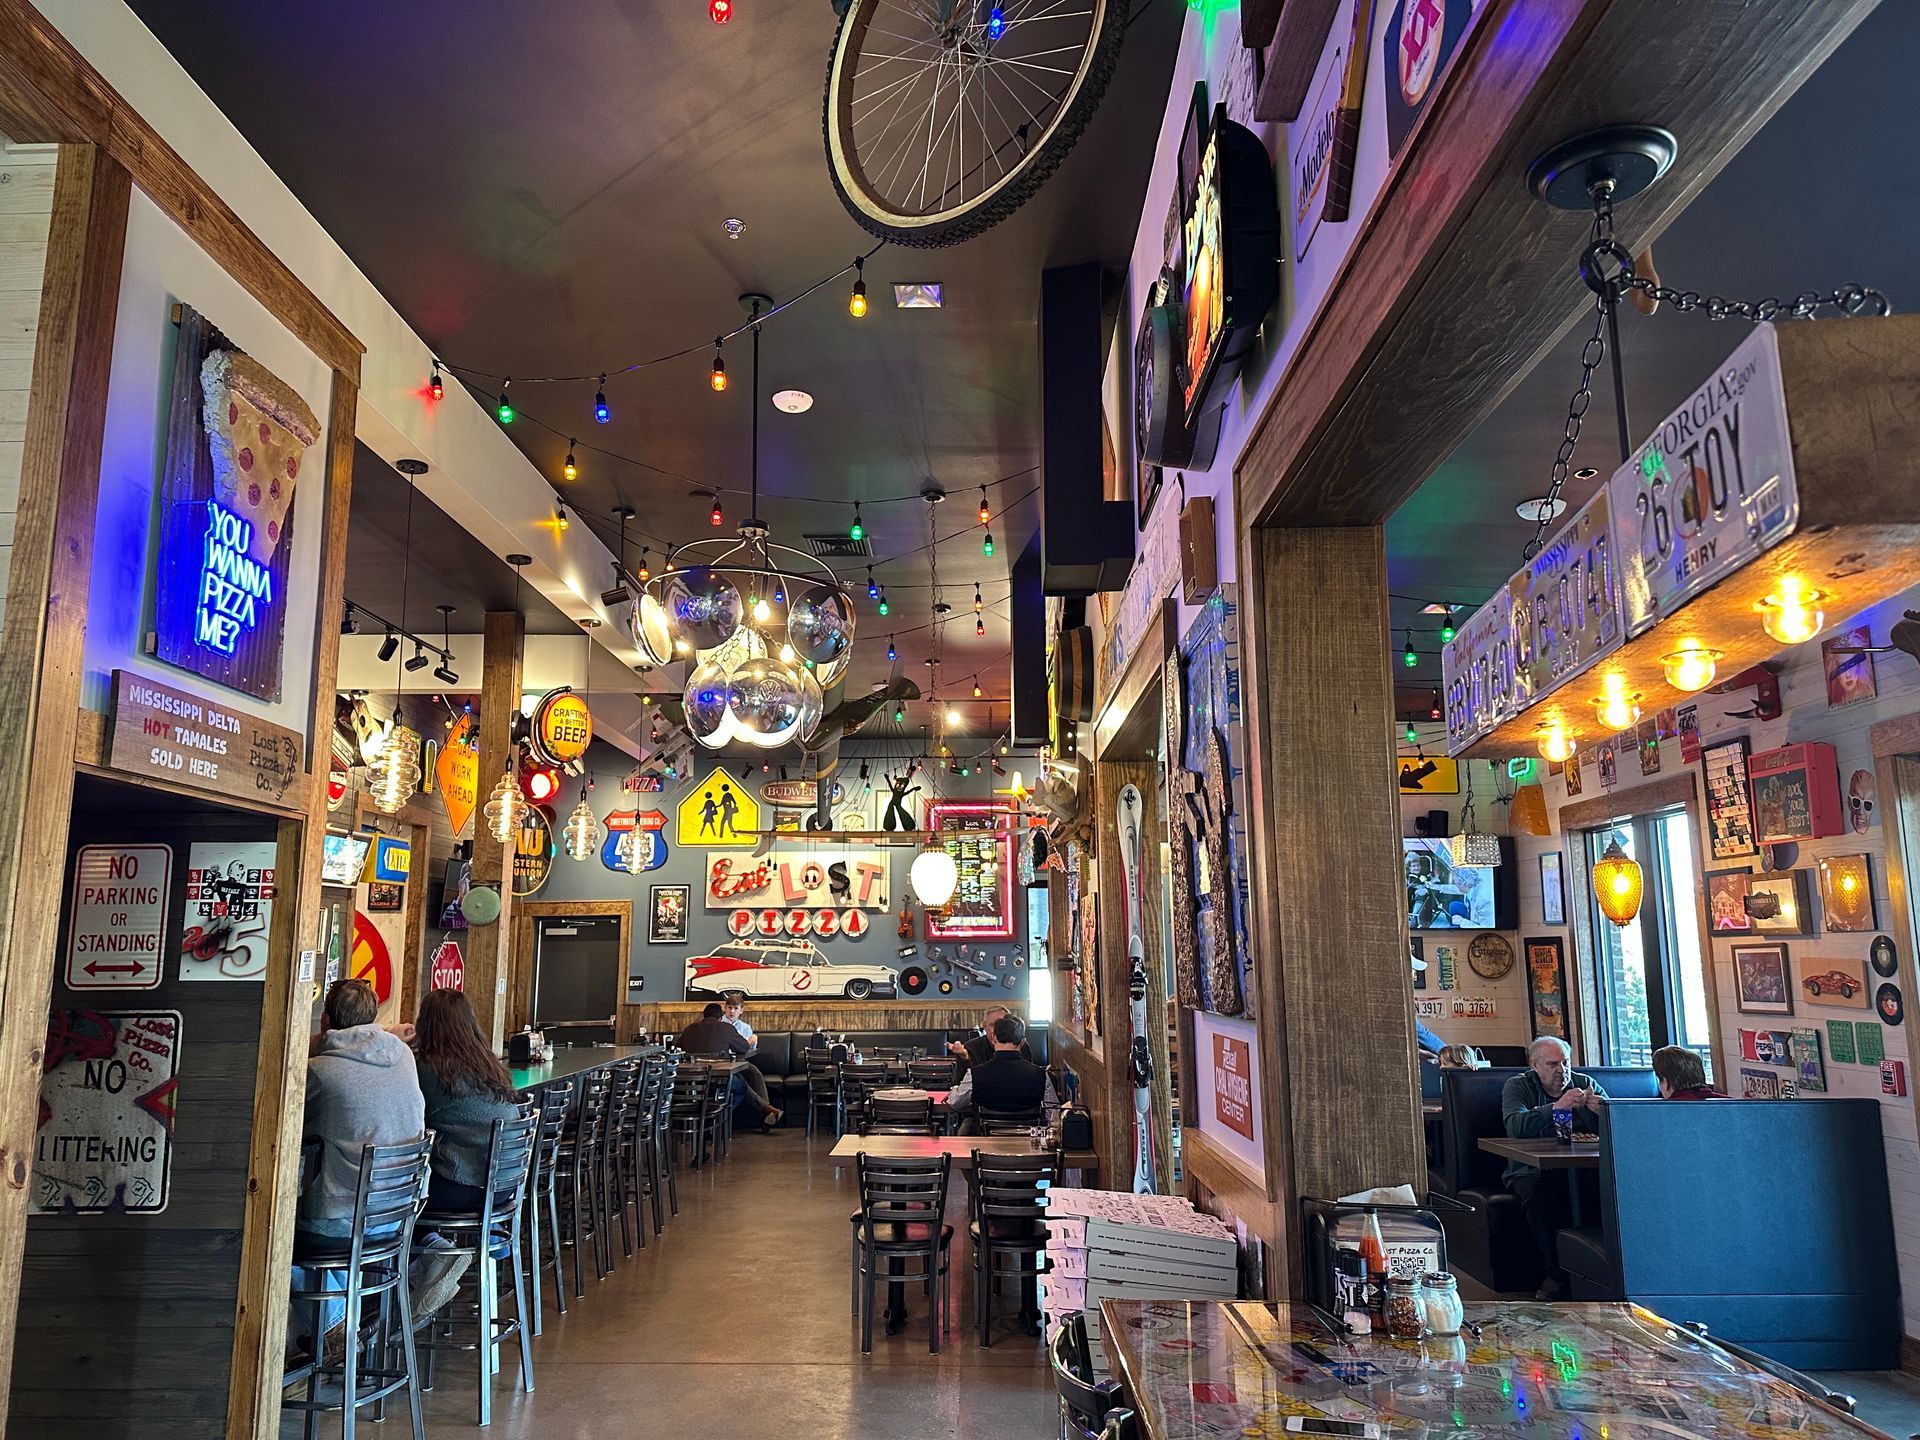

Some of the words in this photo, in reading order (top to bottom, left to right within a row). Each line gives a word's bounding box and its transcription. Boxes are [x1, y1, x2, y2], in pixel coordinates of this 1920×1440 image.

[1636, 477, 1675, 577] 26
[1678, 401, 1746, 537] TOY
[212, 503, 250, 553] YOU
[209, 536, 272, 603] WANNA
[1675, 538, 1718, 584] HENRY
[204, 572, 255, 627] PIZZA
[200, 608, 240, 653] ME?
[129, 685, 202, 722] MISSISSIPPI
[208, 710, 241, 734] DELTA
[553, 708, 587, 720] CRAFTING
[144, 718, 170, 739] HOT
[174, 727, 227, 755] TAMALES
[253, 731, 279, 752] Lost
[553, 726, 587, 744] BEER
[151, 748, 183, 770] SOLD
[189, 757, 218, 779] HERE
[250, 750, 281, 772] Pizza
[451, 761, 471, 782] WORK
[256, 773, 272, 792] Co.
[623, 777, 659, 792] PIZZA
[447, 785, 473, 804] AHEAD
[109, 856, 138, 879] NO
[711, 858, 772, 898] Eat
[779, 861, 884, 901] LOST
[84, 887, 158, 905] PARKING
[111, 913, 127, 926] OR
[735, 911, 861, 933] PIZZA
[77, 934, 156, 952] STANDING
[434, 969, 462, 989] STOP
[1421, 1002, 1443, 1014] 3917
[1469, 1002, 1494, 1015] 37621
[135, 1016, 174, 1038] Lost
[121, 1029, 170, 1057] Pizza
[128, 1052, 153, 1072] Co.
[85, 1060, 127, 1094] NO
[1222, 1098, 1245, 1124] CENTER
[1398, 1247, 1421, 1255] PIZZA
